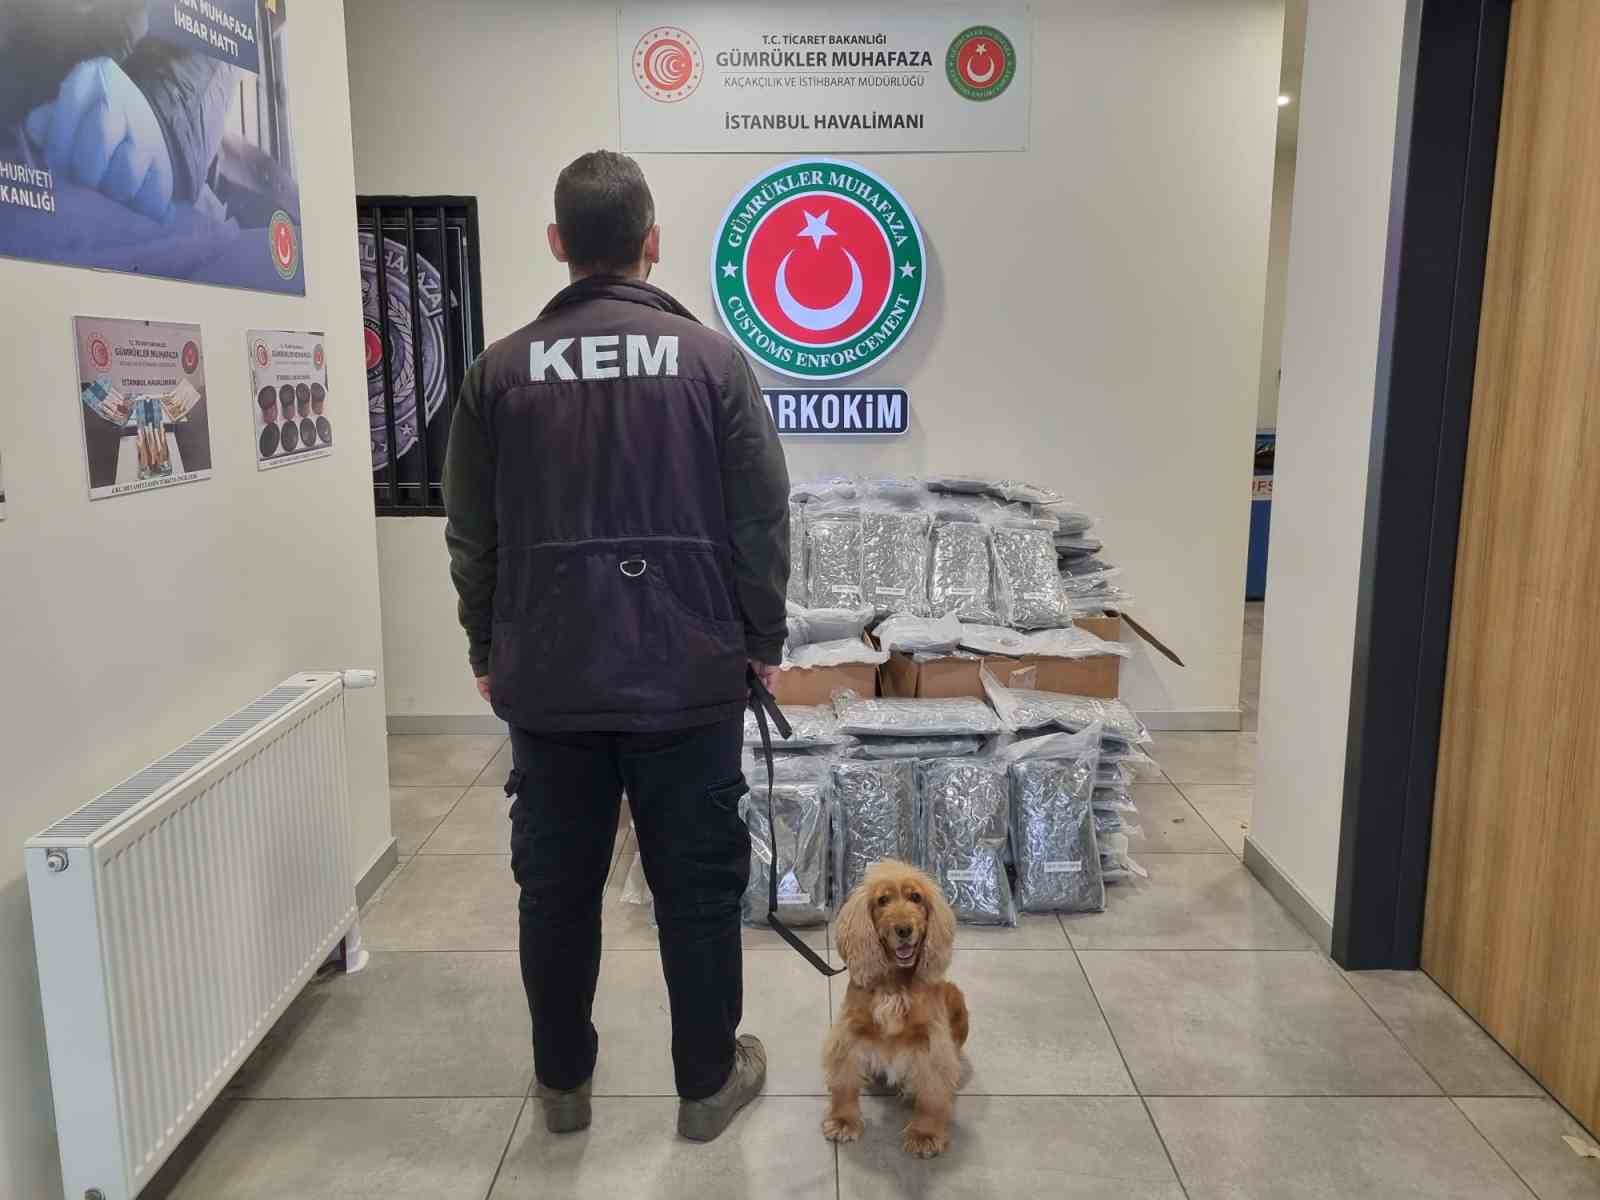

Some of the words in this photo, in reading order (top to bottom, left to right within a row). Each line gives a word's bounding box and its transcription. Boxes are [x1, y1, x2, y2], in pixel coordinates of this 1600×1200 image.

[174, 3, 208, 41] İHBAR
[210, 27, 239, 57] HATTI
[200, 0, 255, 44] MUHAFAZA
[762, 35, 780, 45] T.C.
[783, 33, 825, 45] TİCARET
[829, 33, 887, 45] BAKANLIĞI
[716, 48, 827, 67] GÜMRÜKLER
[832, 51, 933, 67] MUHAFAZA
[724, 77, 782, 88] KAÇAKÇILIK
[784, 77, 797, 87] VE
[859, 75, 925, 87] MÜDÜRLÜĞÜ
[725, 112, 810, 129] İSTANBUL
[814, 112, 924, 129] HAVALİMANI
[0, 184, 55, 212] KANLIĞI
[728, 170, 824, 247] GÜMRÜKLER
[828, 171, 908, 247] MUHAFAZA
[727, 296, 793, 362] CUSTOMS
[796, 294, 910, 368] ENFORCEMENT
[529, 335, 679, 381] KEM
